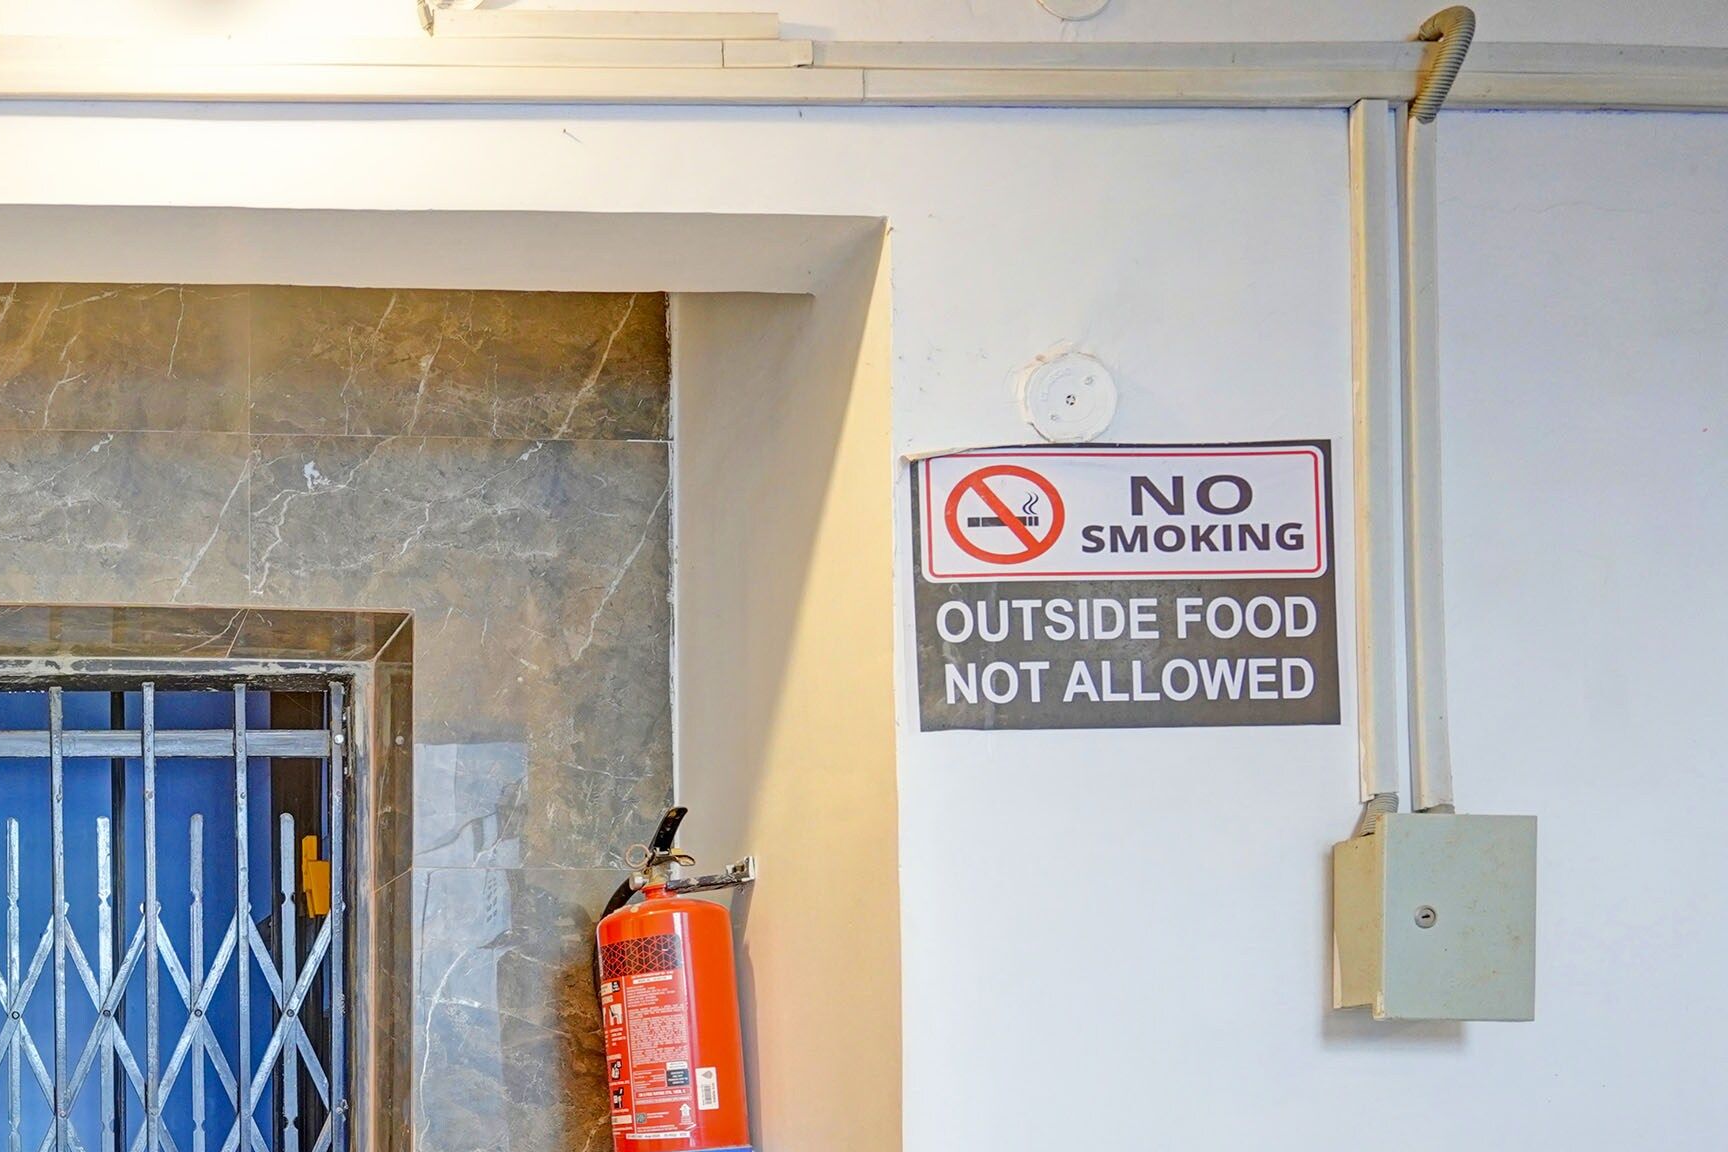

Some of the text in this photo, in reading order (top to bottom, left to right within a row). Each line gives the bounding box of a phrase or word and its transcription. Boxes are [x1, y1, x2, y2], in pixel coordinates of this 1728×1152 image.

[1130, 474, 1253, 517] NO
[1081, 522, 1305, 554] SMOKING
[936, 595, 1318, 643] OUTSIDE FOOD
[944, 657, 1315, 705] NOT ALLOWED
